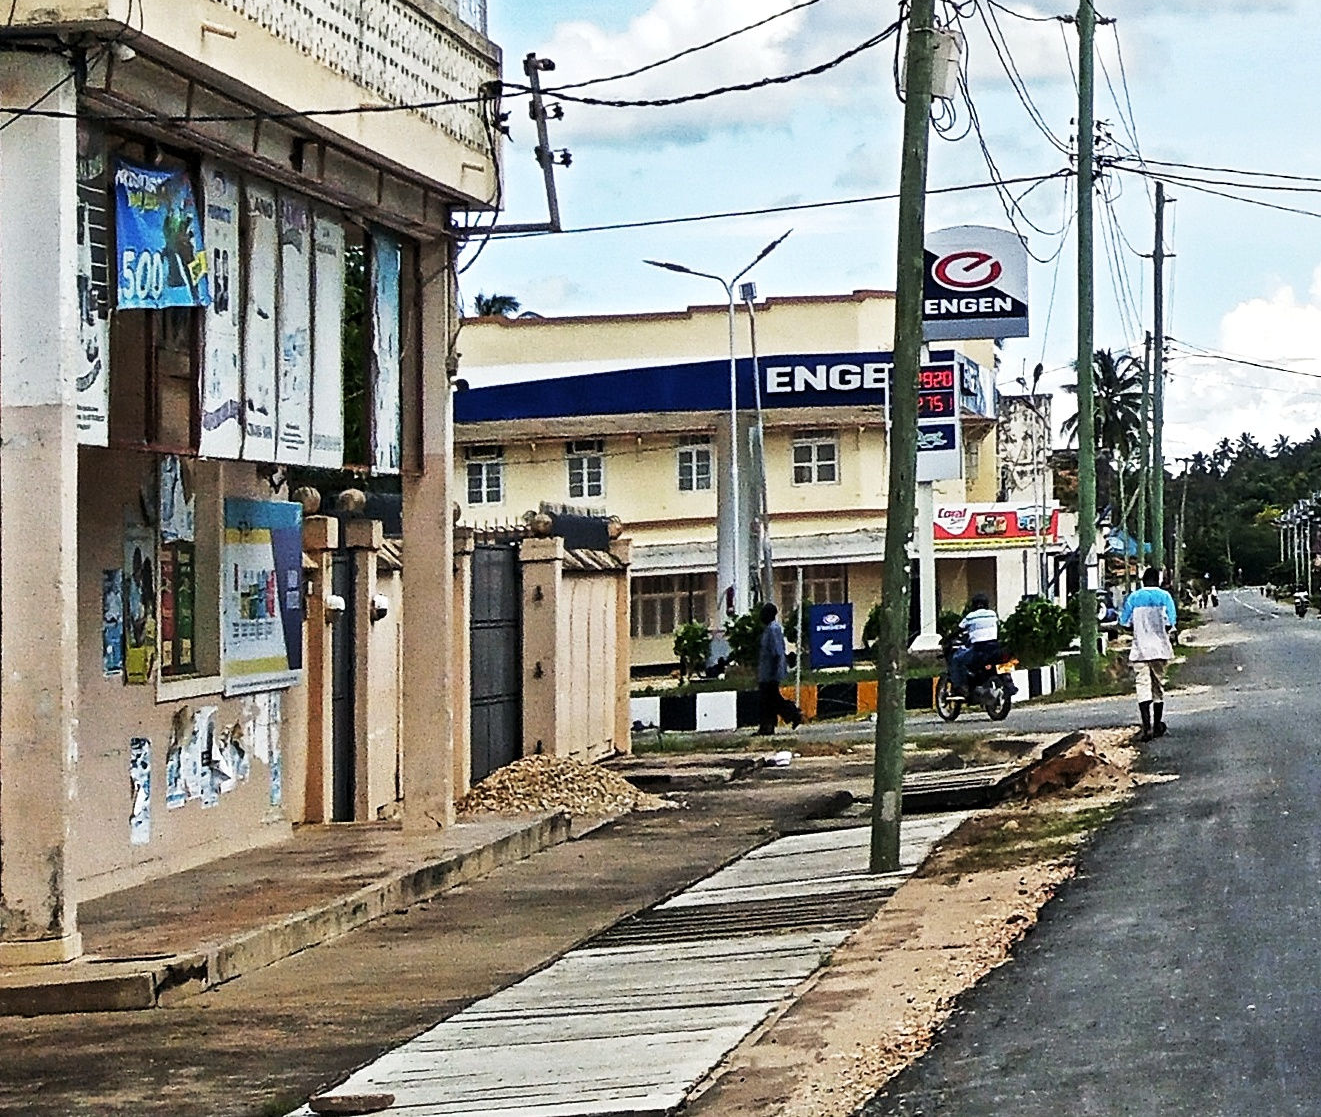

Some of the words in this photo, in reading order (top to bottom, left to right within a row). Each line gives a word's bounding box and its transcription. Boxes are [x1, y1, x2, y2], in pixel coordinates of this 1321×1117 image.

[122, 249, 164, 300] 500
[925, 297, 1012, 315] ENGEN
[766, 362, 893, 393] ENGE
[938, 508, 968, 519] Coral
